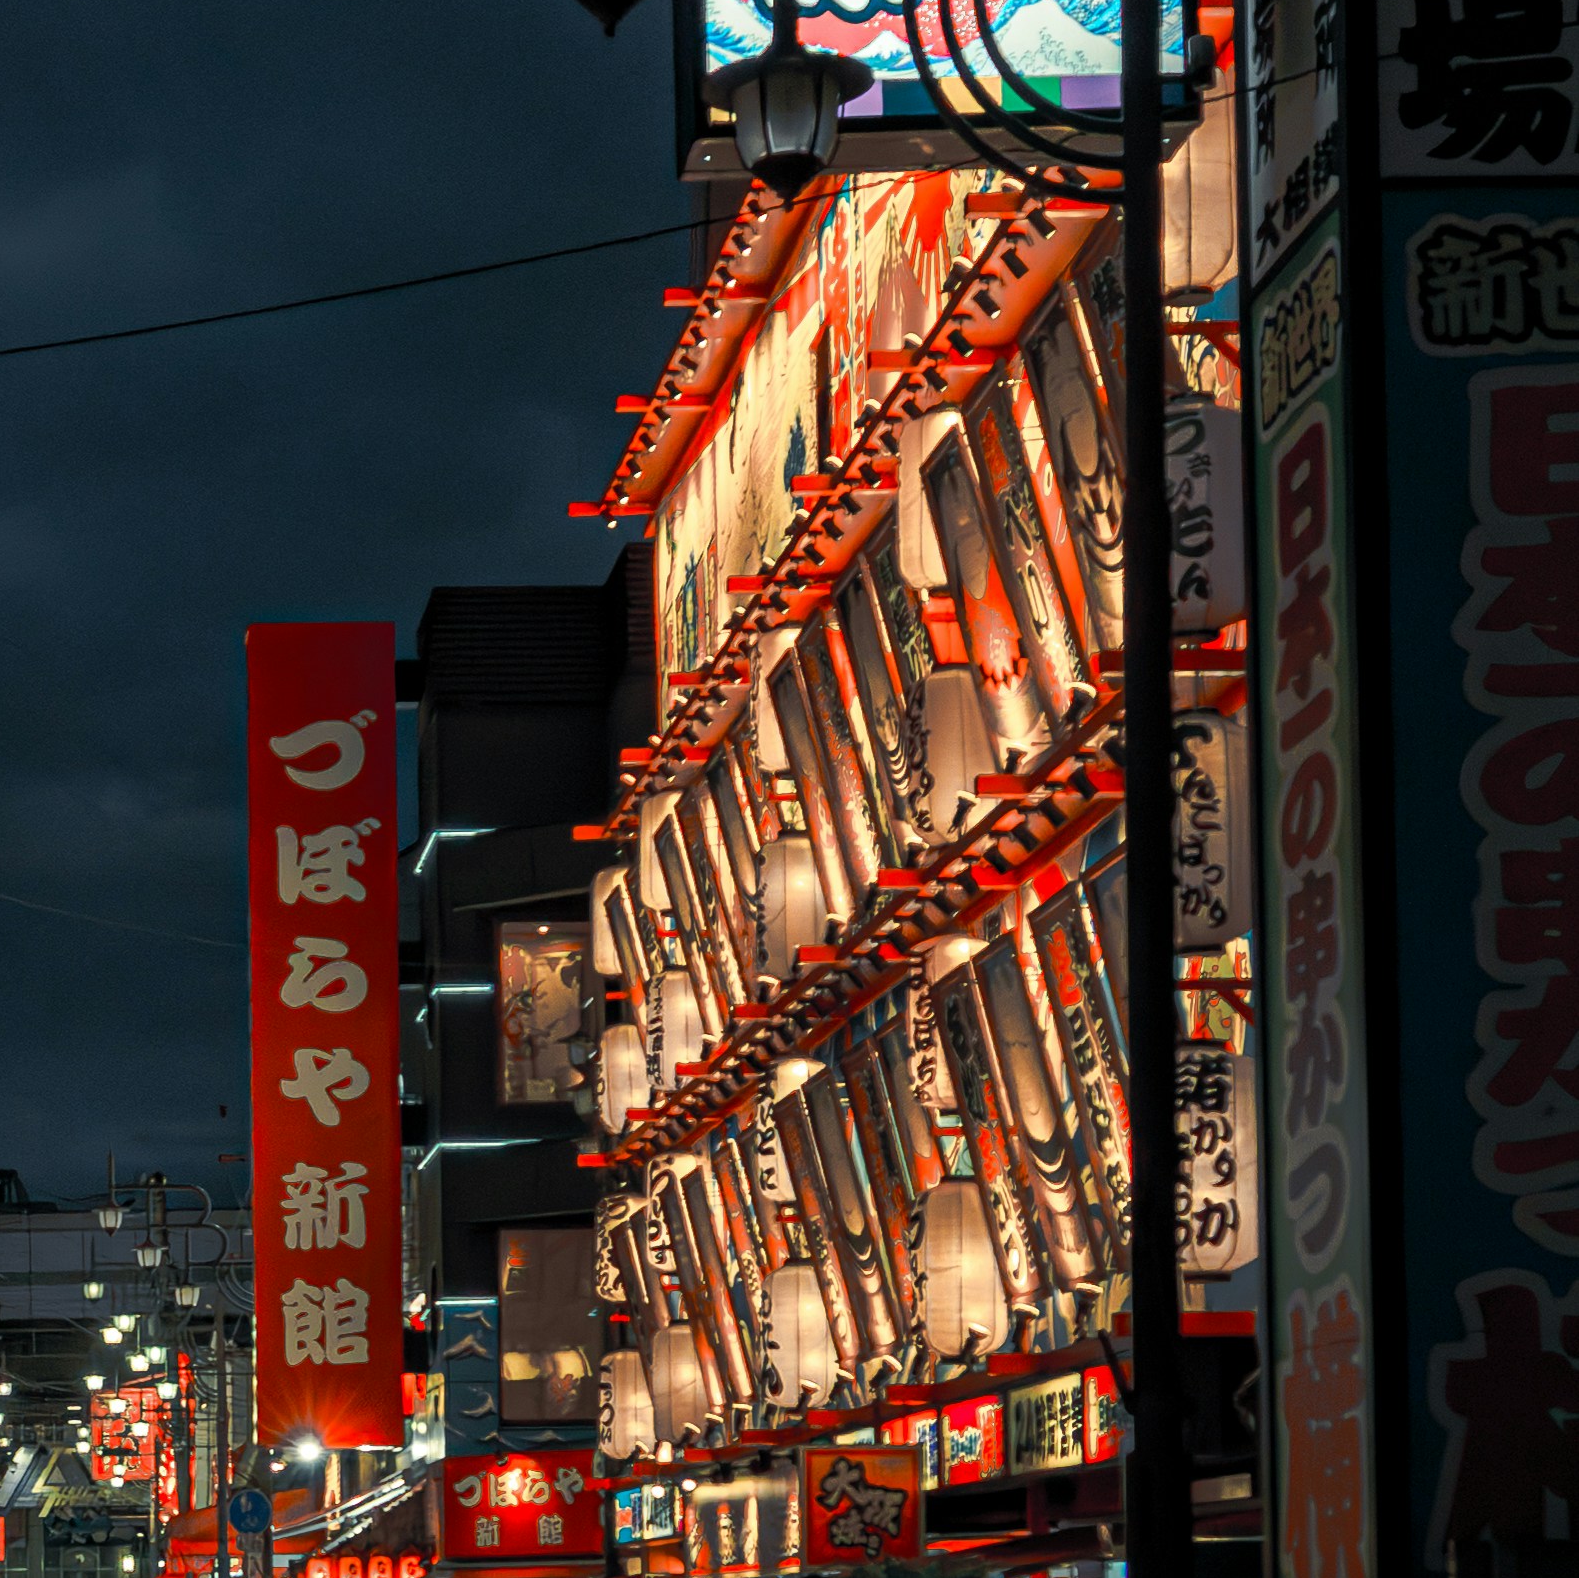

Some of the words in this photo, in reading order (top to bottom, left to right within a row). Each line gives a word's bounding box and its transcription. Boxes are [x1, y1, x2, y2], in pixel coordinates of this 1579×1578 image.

[1261, 247, 1341, 427] 新世界
[1275, 422, 1347, 1257] 日本一の串かつ
[269, 708, 382, 1366] づぼらや新館
[453, 1467, 584, 1508] づぼらや
[476, 1515, 564, 1548] 新館
